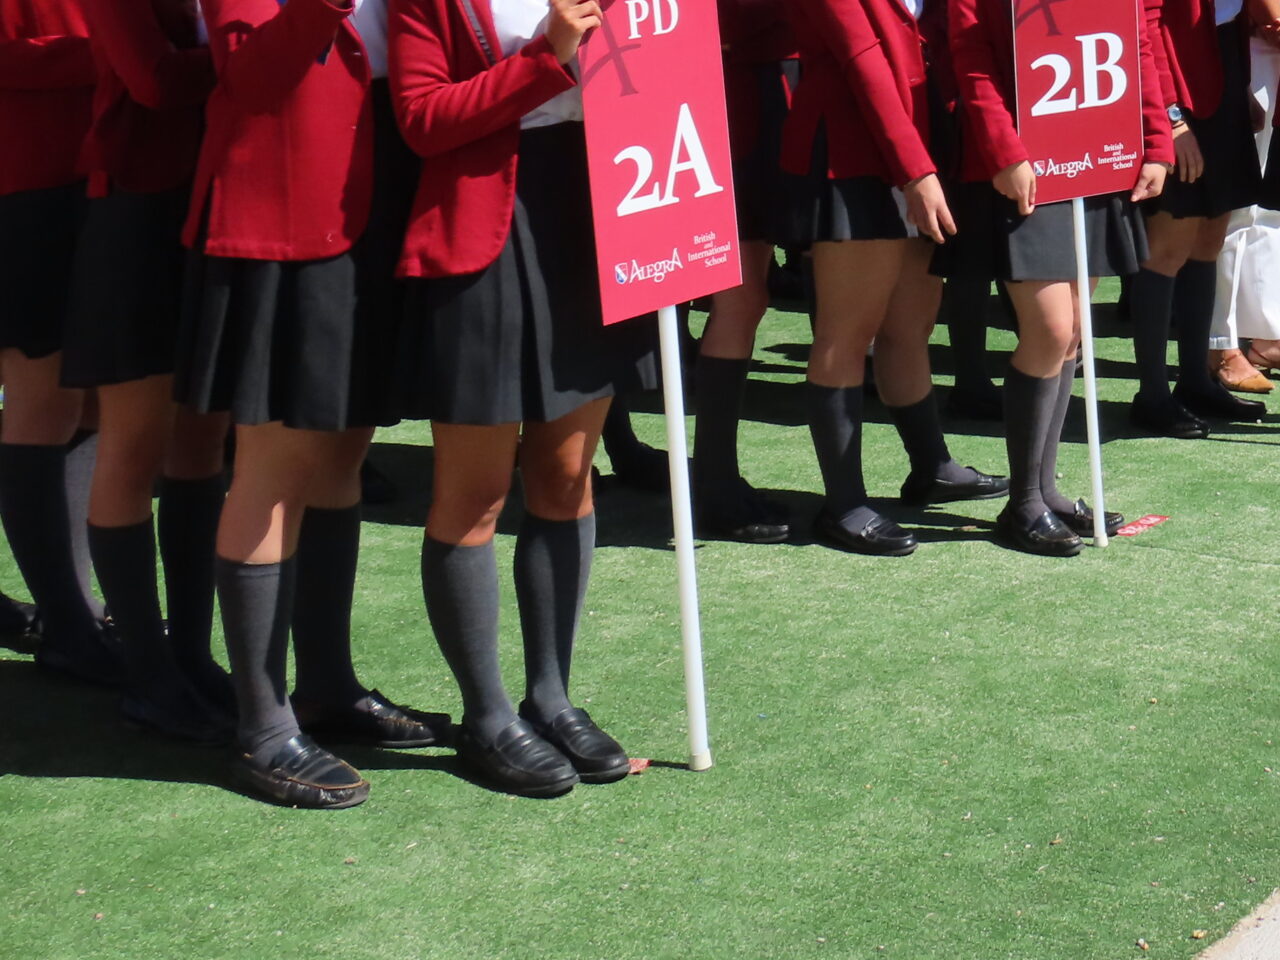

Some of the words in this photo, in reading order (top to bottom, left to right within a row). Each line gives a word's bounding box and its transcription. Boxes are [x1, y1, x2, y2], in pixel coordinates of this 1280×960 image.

[1030, 32, 1128, 117] 2B
[1103, 142, 1124, 152] British
[613, 102, 724, 217] 2A
[1097, 151, 1137, 165] International
[1112, 160, 1133, 171] School
[693, 231, 716, 245] British
[687, 241, 731, 262] International
[704, 253, 727, 268] School
